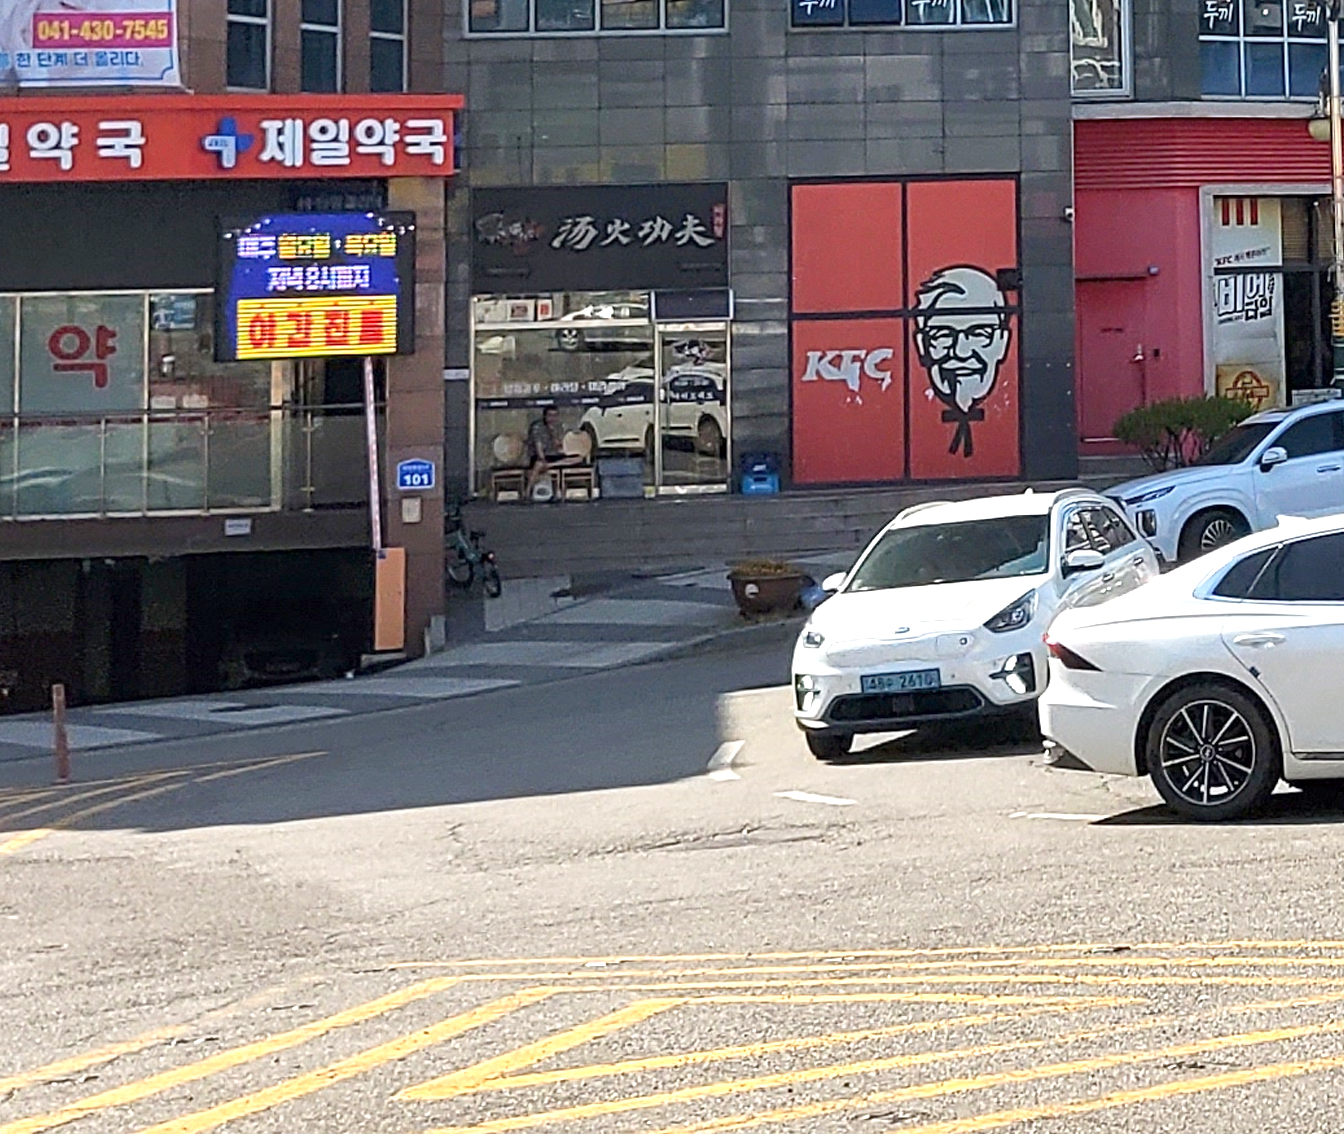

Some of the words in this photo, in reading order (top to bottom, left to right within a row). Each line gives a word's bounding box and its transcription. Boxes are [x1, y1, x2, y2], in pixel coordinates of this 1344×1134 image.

[37, 18, 169, 42] 041-430-7545
[258, 118, 448, 167] 제일약국
[47, 323, 118, 389] 약
[801, 347, 895, 391] KFC
[403, 473, 429, 486] 101
